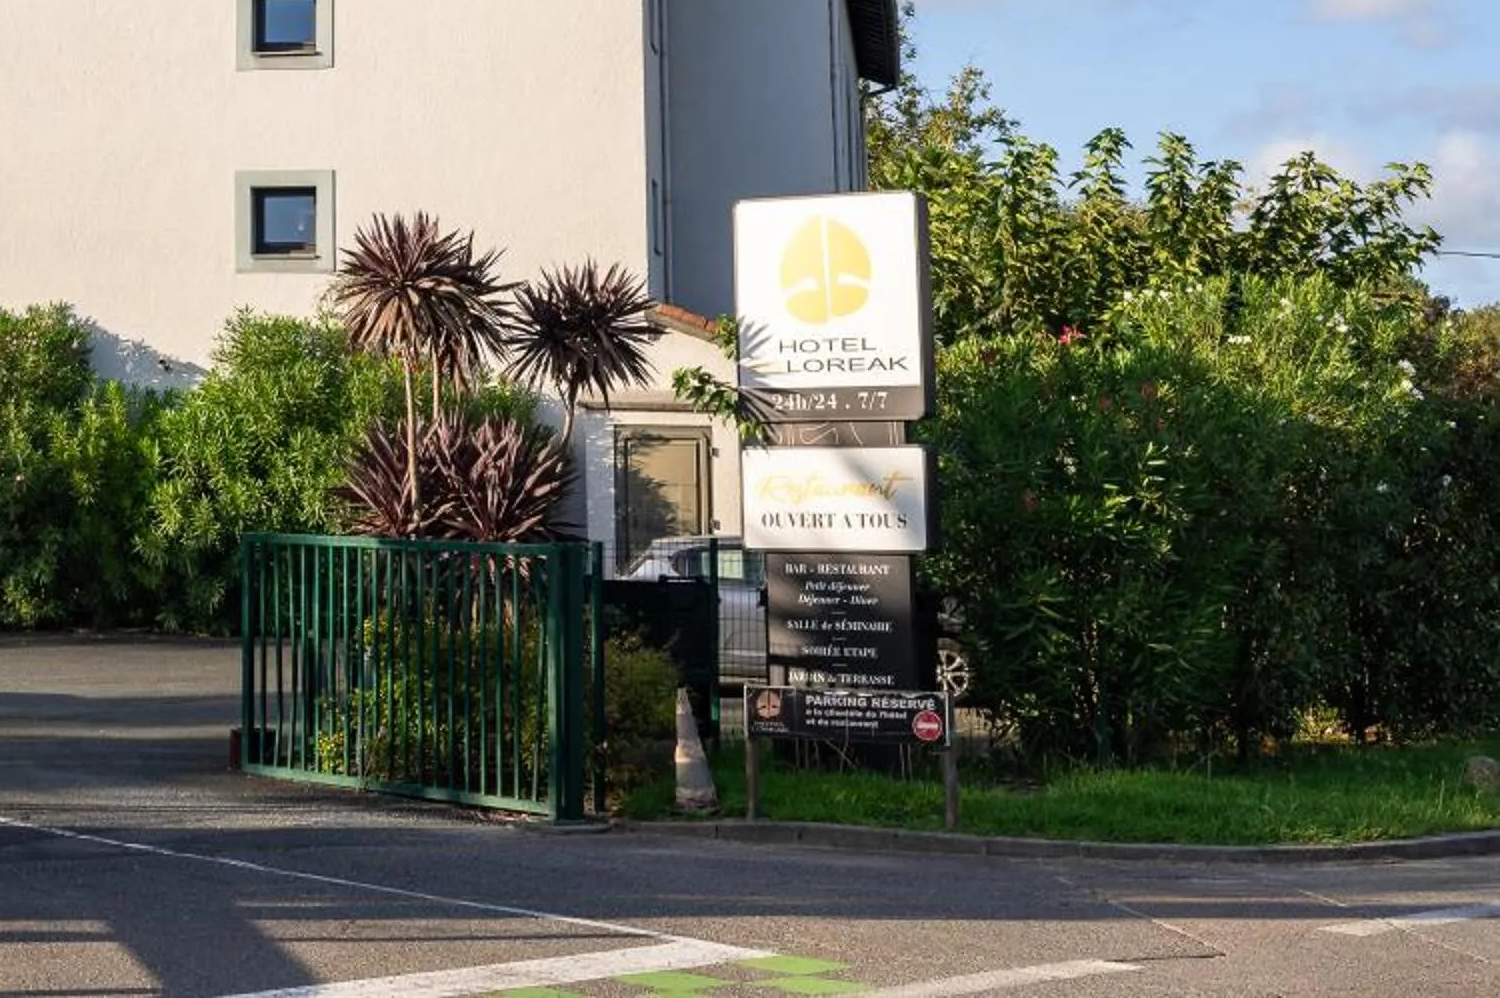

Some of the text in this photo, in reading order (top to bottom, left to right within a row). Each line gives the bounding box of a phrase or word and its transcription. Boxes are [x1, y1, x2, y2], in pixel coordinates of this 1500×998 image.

[779, 338, 877, 354] HOTEL
[787, 356, 908, 373] LOREAK
[772, 393, 837, 410] 24h/24
[857, 391, 888, 410] 7/7
[761, 512, 836, 529] OUVERT
[856, 512, 908, 529] TOUS
[785, 563, 807, 575] BAR
[817, 563, 891, 575] RESTAURANT
[787, 619, 819, 630] SALLE
[838, 673, 896, 686] TERRASSE
[805, 694, 867, 707] PARKING
